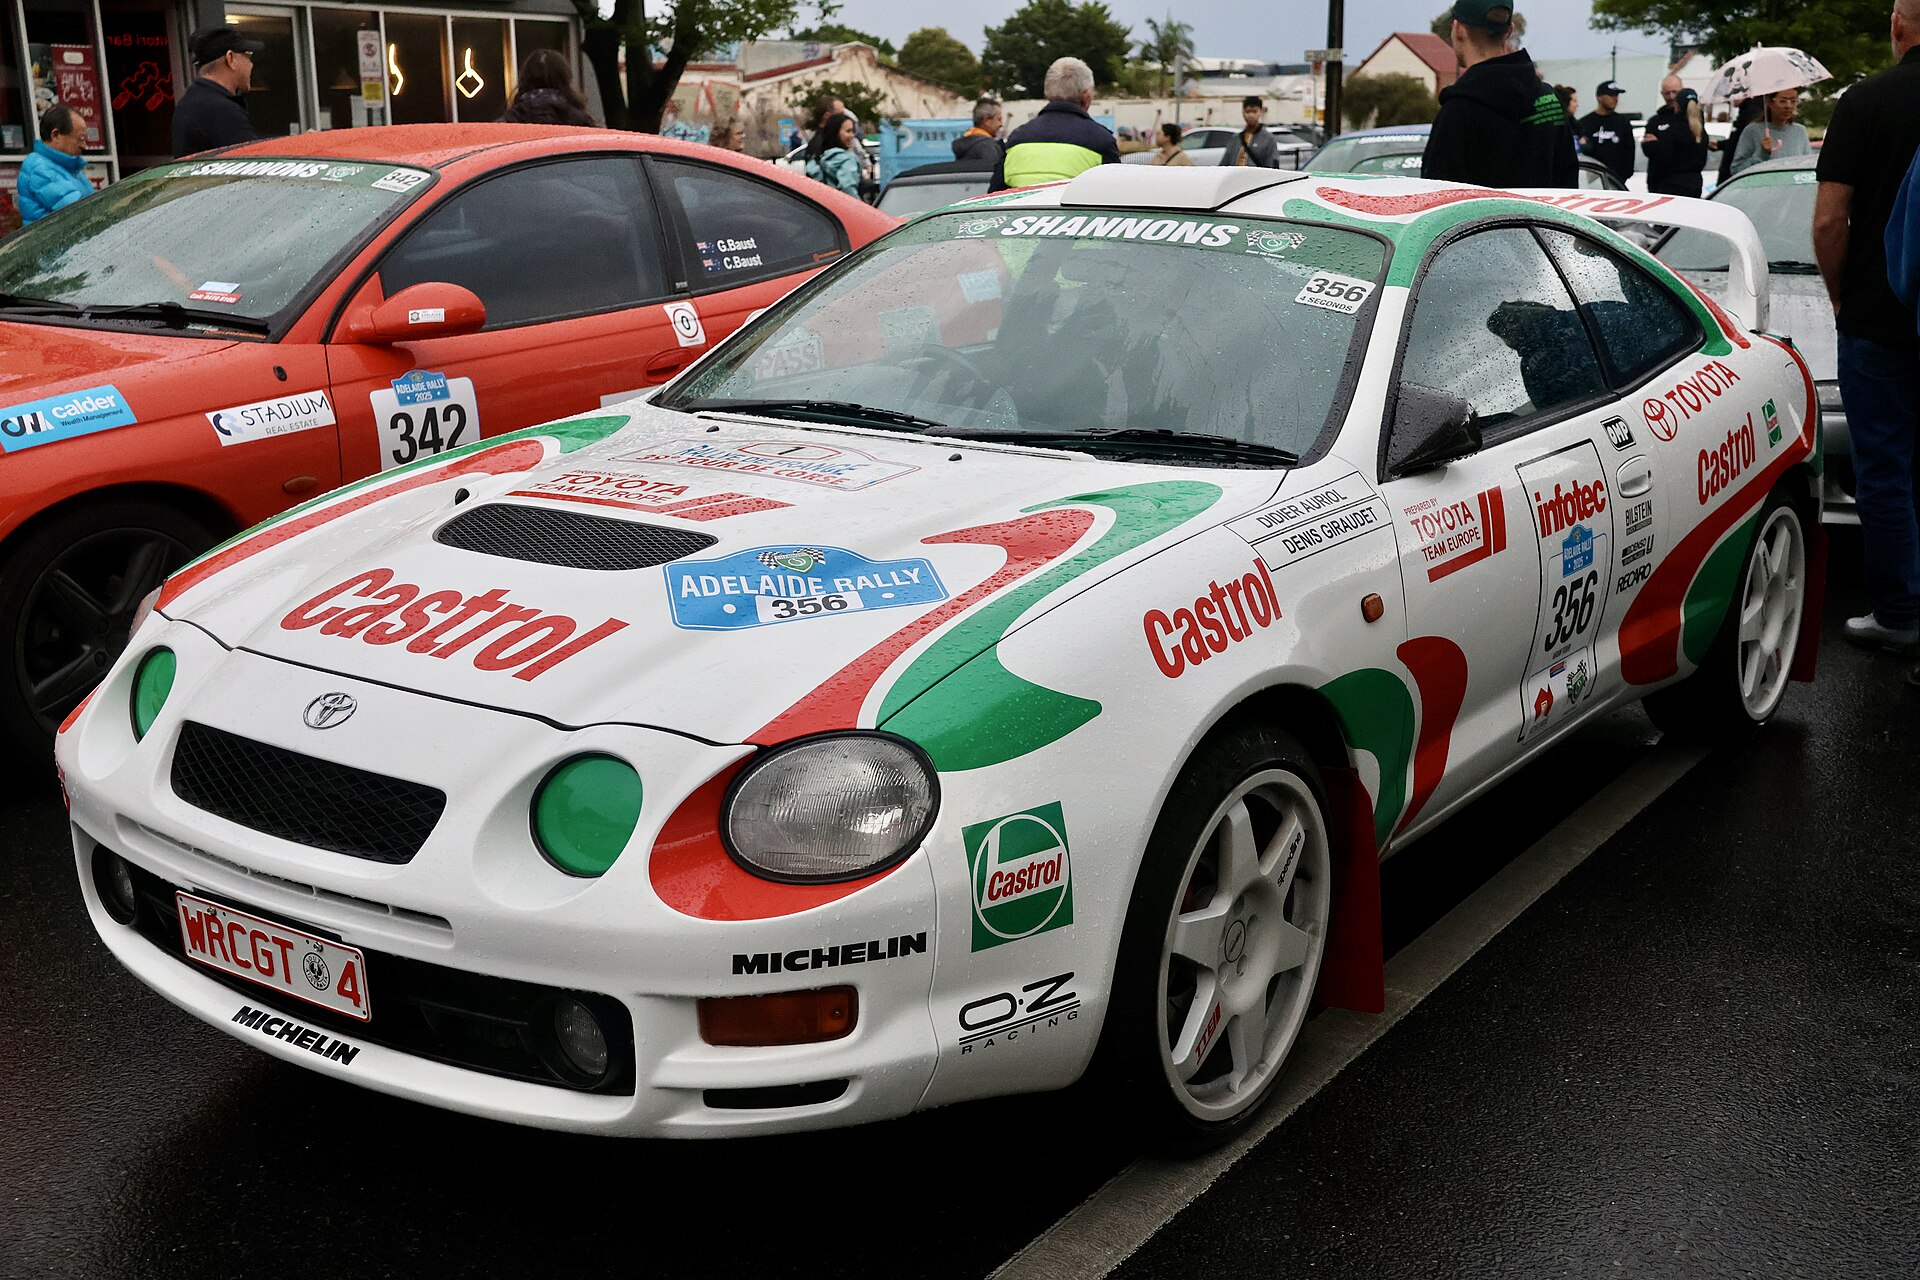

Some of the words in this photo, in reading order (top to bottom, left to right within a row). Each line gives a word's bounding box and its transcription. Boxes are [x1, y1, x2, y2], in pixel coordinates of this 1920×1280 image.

[192, 161, 330, 178] SHANNONS
[383, 171, 422, 187] 342
[717, 237, 757, 252] G.Baust
[1000, 216, 1241, 248] SHANNONS
[723, 254, 763, 269] C.Baust
[1306, 278, 1367, 302] 356
[1307, 296, 1353, 312] SECONDS
[757, 344, 821, 381] PASS
[396, 382, 427, 395] ADELAIDE
[427, 378, 445, 390] RALLY
[414, 393, 433, 402] 2025
[1665, 361, 1741, 420] TOYOTA
[52, 395, 115, 418] calder
[60, 416, 83, 427] Wealth
[82, 408, 124, 422] Management
[241, 395, 330, 426] STADIUM
[265, 426, 288, 435] REAL
[289, 418, 319, 430] ESTATE
[390, 404, 467, 465] 342
[1606, 423, 1629, 445] OMP
[677, 444, 744, 461] RALLYE
[742, 456, 775, 464] DE
[769, 459, 870, 475] FRANCE
[678, 457, 739, 468] TOUR
[738, 463, 775, 473] DE
[773, 468, 851, 485] CORSE
[1698, 411, 1756, 506] Castrol
[529, 482, 584, 493] TEAM
[583, 486, 672, 504] EUROPE
[550, 473, 690, 496] TOYOTA
[1256, 505, 1303, 529] DIDIER
[1300, 488, 1348, 513] AURIOL
[1403, 500, 1431, 517] PREPARED
[1430, 497, 1439, 507] BY
[1410, 500, 1475, 542] TOYOTA
[1534, 479, 1607, 539] infotec
[1625, 499, 1653, 527] BILSTEIN
[1282, 528, 1323, 554] DENIS
[1320, 506, 1378, 540] GIRAUDET
[1421, 540, 1448, 562] TEAM
[1446, 526, 1481, 552] EUROPE
[681, 574, 824, 598] ADELAIDE
[832, 567, 921, 593] RALLY
[1616, 563, 1652, 595] RECARO
[771, 593, 848, 619] 356
[1143, 557, 1283, 679] Castrol
[1544, 569, 1598, 652] 356
[280, 567, 631, 682] Castrol
[1277, 832, 1302, 887] speedline
[987, 852, 1063, 902] Castrol
[182, 905, 294, 985] WRCGT
[336, 960, 362, 1008] 4
[732, 932, 927, 975] MICHELIN
[231, 1005, 361, 1066] MICHELIN
[961, 1010, 1078, 1055] RACING
